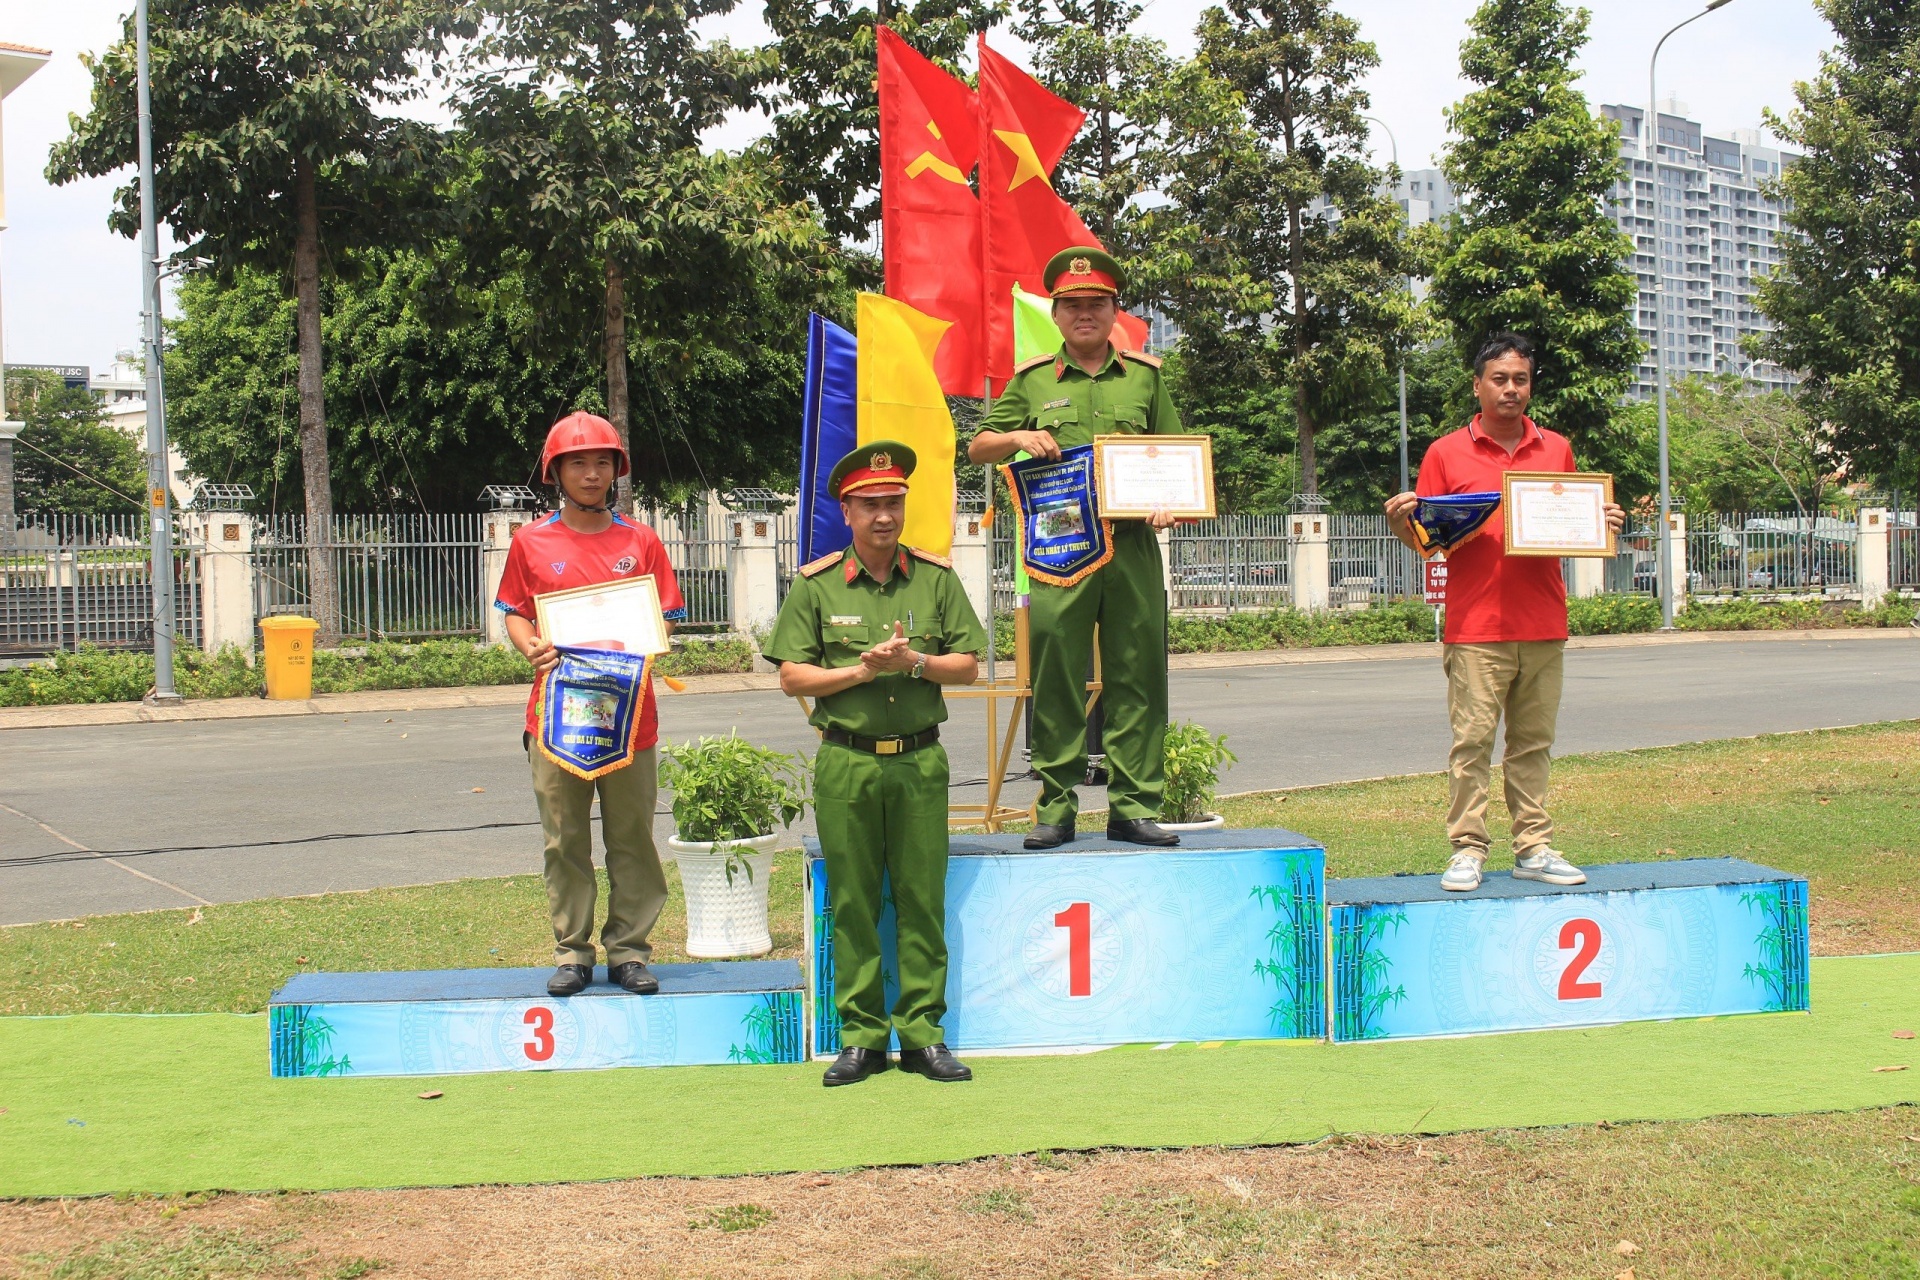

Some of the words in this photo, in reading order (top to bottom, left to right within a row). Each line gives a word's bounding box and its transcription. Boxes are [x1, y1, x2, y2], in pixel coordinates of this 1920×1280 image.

[1034, 545, 1045, 556] GIẢI
[1046, 543, 1060, 555] NHẤT
[1061, 543, 1068, 553] LÝ
[1069, 539, 1090, 552] THUYẾT
[1431, 564, 1447, 577] CẤM
[1430, 579, 1437, 587] TỤ
[576, 735, 585, 744] BA
[586, 734, 593, 745] LÝ
[595, 736, 613, 748] THUYẾT
[1055, 903, 1091, 997] 1
[1558, 918, 1602, 1000] 2
[523, 1006, 555, 1062] 3
